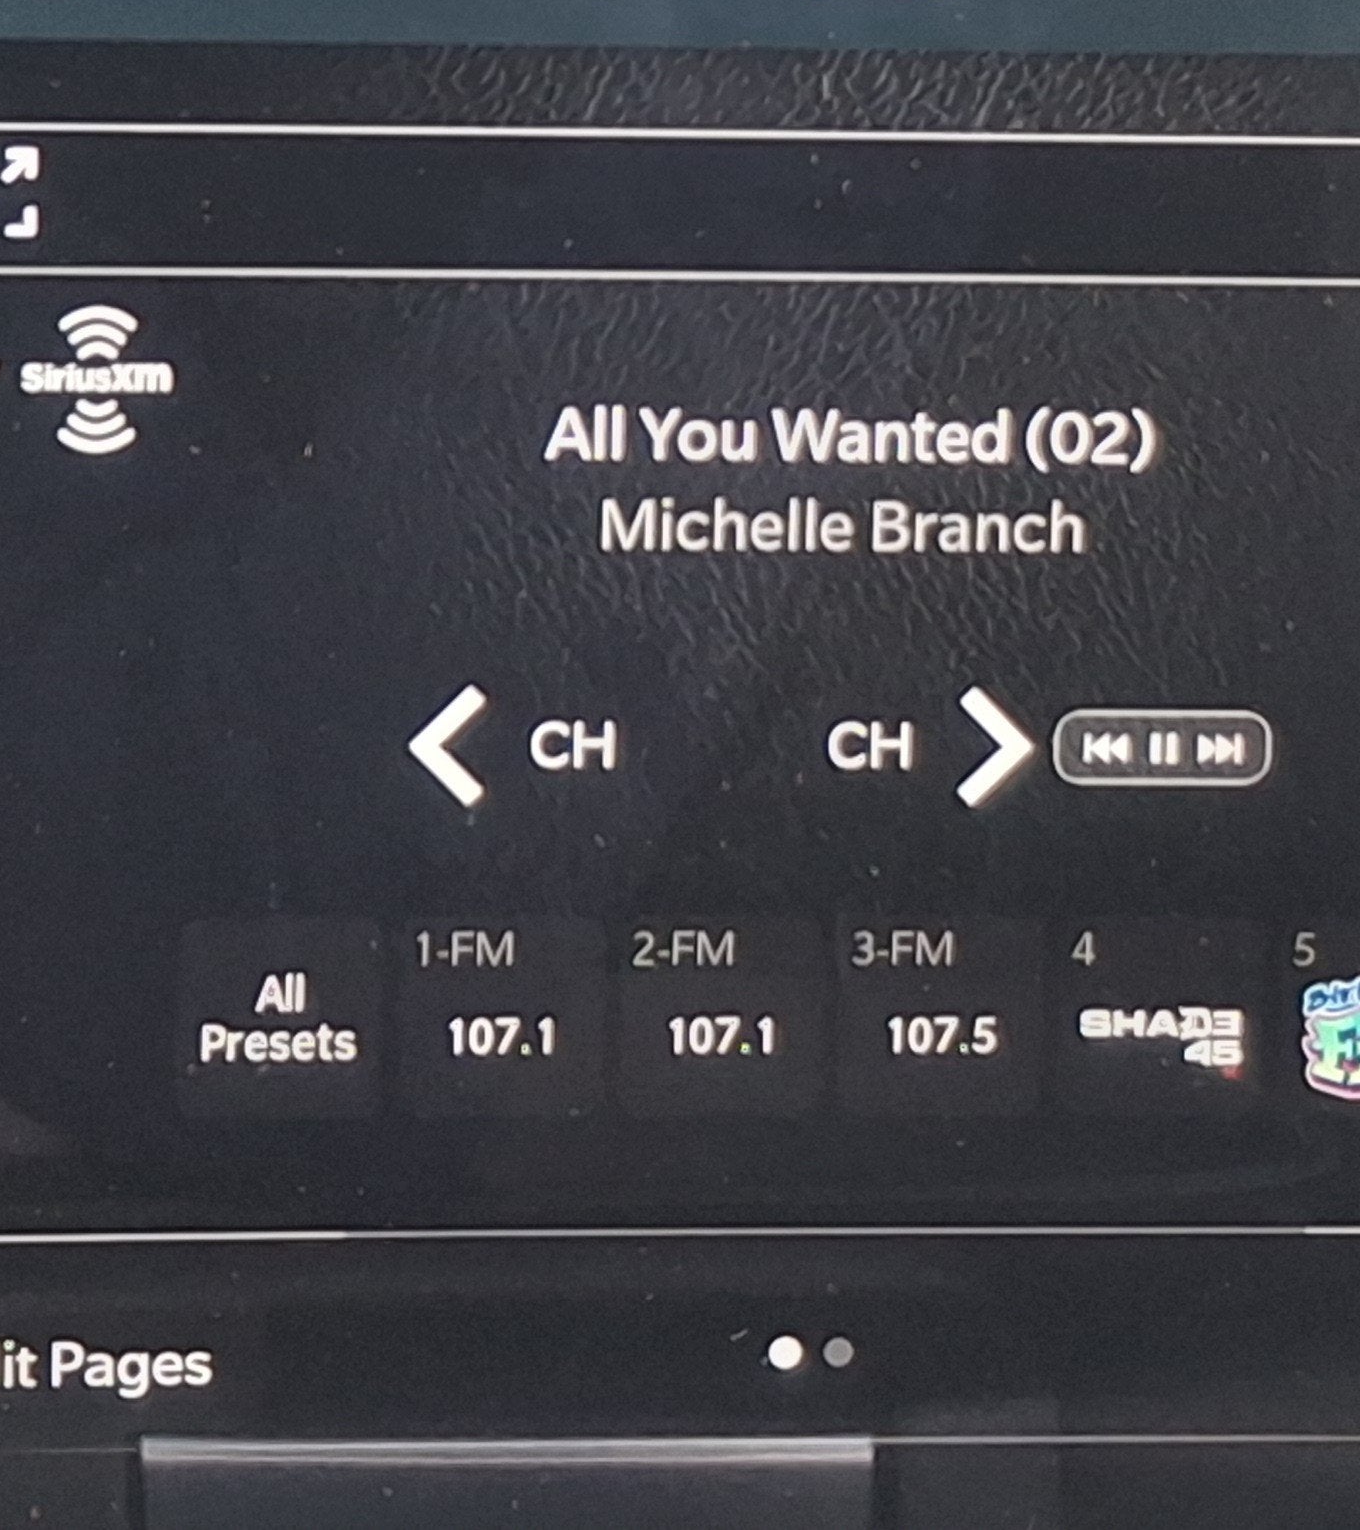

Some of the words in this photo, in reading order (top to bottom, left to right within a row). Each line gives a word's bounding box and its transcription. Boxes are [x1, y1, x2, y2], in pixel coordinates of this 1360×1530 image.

[543, 404, 627, 464] All
[638, 406, 757, 465] You
[771, 406, 1011, 466] Wanted
[1024, 406, 1157, 474] (02)
[598, 498, 856, 554] Michelle
[870, 499, 1089, 555] Branch
[528, 718, 618, 771] CH
[826, 718, 915, 772] CH
[415, 928, 516, 968] 1-FM
[631, 929, 736, 968] 2-FM
[851, 929, 956, 967] 3-FM
[1070, 930, 1098, 967] 4
[1291, 931, 1317, 968] 5
[254, 971, 307, 1014] All
[199, 1021, 358, 1063] Presets
[447, 1015, 558, 1057] 107.1
[667, 1015, 778, 1057] 107.1
[887, 1015, 1000, 1057] 107.5
[1078, 1006, 1245, 1041] SHADE
[1183, 1040, 1244, 1066] 45
[49, 1341, 213, 1399] Pages
